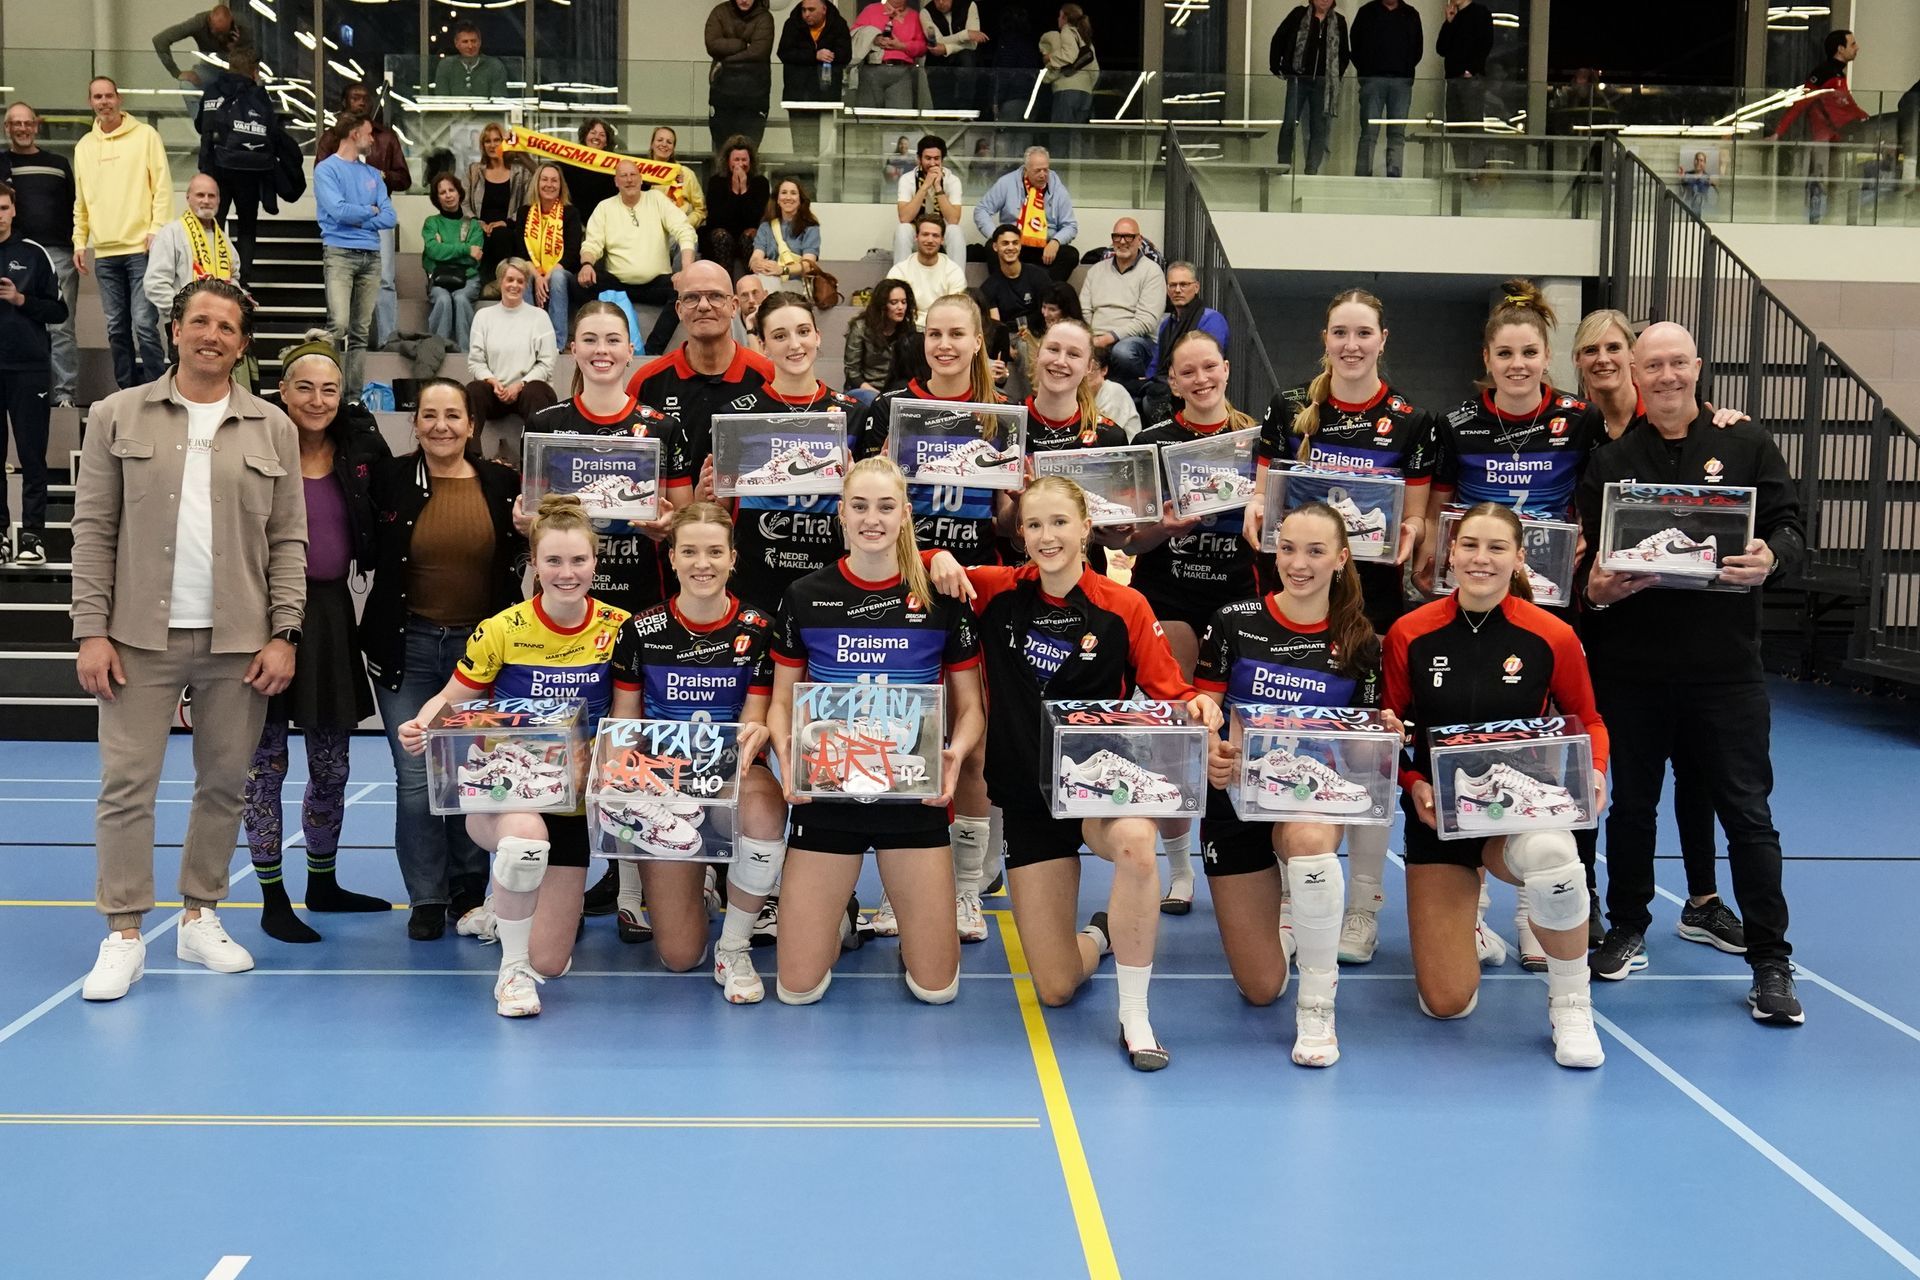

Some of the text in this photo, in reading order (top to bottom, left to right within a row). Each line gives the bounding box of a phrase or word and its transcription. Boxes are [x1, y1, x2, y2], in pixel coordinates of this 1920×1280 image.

[234, 121, 250, 131] VAN
[527, 136, 673, 180] DRAISMA DYAMO
[1322, 421, 1372, 433] MASTERMATE
[1494, 425, 1545, 443] MASTERMATE
[770, 438, 833, 450] Draisma
[572, 458, 637, 471] Draisma
[1310, 448, 1374, 469] Draisma
[1486, 459, 1552, 471] Draisma
[1041, 463, 1083, 474] aisma
[1180, 462, 1239, 474] Draisma
[1180, 474, 1208, 485] Bou
[1486, 471, 1532, 484] Bouw
[1509, 490, 1529, 513] 7
[935, 517, 979, 540] Firat
[934, 540, 979, 549] BAKERY
[779, 551, 809, 561] NEDER
[779, 560, 824, 569] MAKELAAR
[1184, 563, 1212, 572] NEDER
[1183, 571, 1228, 581] MAKELAAR
[590, 582, 630, 591] AKELAAR
[847, 598, 901, 617] MASTERMATE
[1232, 602, 1263, 612] SHIRO
[635, 612, 667, 629] GOED
[637, 619, 668, 637] HART
[838, 634, 909, 649] Draisma
[1238, 630, 1269, 642] STANNO
[545, 646, 585, 659] MASTERMATE
[676, 642, 730, 660] MASTERMATE
[1024, 634, 1072, 660] Draism
[1270, 642, 1326, 653] MASTERMATE
[836, 649, 886, 663] Bouw
[1024, 649, 1062, 673] ouw
[533, 671, 600, 684] Draisma
[667, 672, 737, 687] Draisma
[1254, 667, 1327, 693] Draisma
[1433, 671, 1443, 688] 6
[530, 682, 580, 697] Bouw
[666, 686, 715, 701] Bouw
[1251, 681, 1302, 703] Bouw
[796, 685, 835, 720] TE
[601, 721, 642, 748] TE
[801, 731, 931, 788] ART 42
[602, 749, 724, 796] ART 40
[1202, 841, 1218, 864] 14
